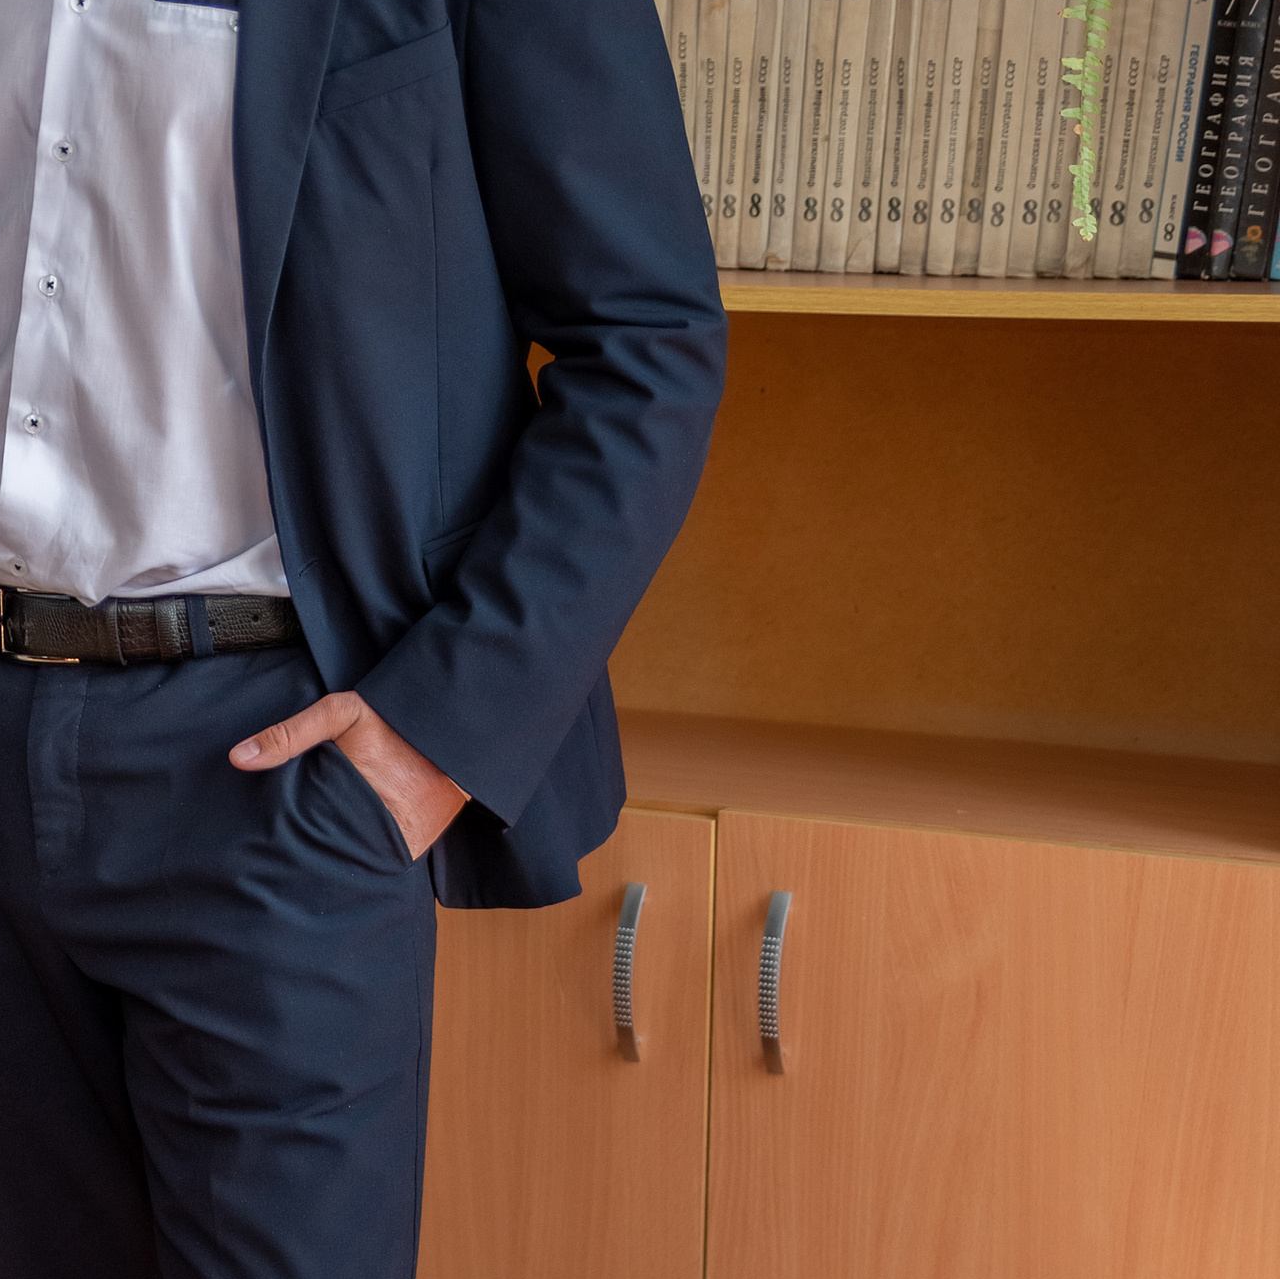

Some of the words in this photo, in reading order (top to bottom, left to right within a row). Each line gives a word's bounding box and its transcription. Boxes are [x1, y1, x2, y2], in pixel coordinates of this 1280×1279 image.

[706, 58, 715, 85] СССР
[733, 57, 743, 85] СССР
[758, 56, 768, 83] СССР
[784, 56, 792, 84] СССР
[815, 58, 824, 87] СССР
[841, 58, 852, 86] СССР
[870, 57, 880, 86] СССР
[926, 60, 936, 88] СССР
[952, 57, 963, 85] СССР
[980, 57, 992, 85] СССР
[1005, 59, 1016, 88] СССР
[1037, 57, 1048, 86] СССР
[1128, 57, 1139, 86] СССР
[1158, 55, 1170, 84] СССР
[1182, 44, 1200, 113] ГЕОГРАФИЯ
[1175, 114, 1191, 162] РОССИИ
[1193, 54, 1231, 212] ГЕОГРАФИЯ
[1218, 55, 1255, 213] ГЕОГРАФИЯ
[1163, 223, 1176, 242] 8
